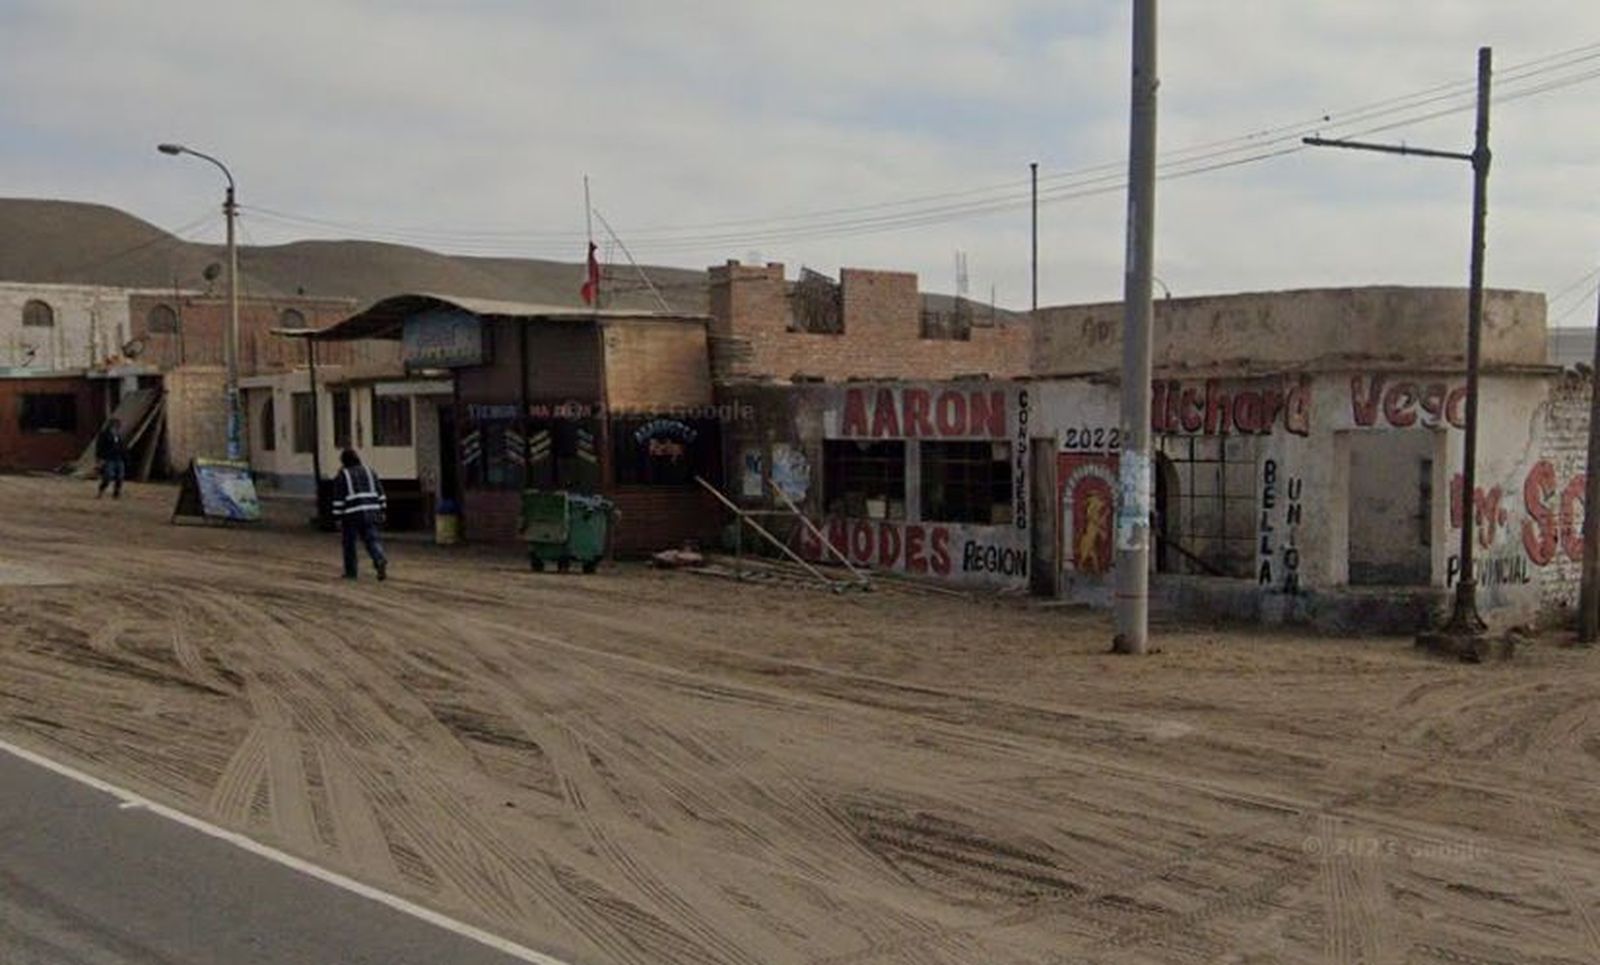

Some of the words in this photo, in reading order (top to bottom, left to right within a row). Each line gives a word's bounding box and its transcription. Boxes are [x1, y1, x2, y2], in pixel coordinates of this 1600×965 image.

[842, 387, 1006, 438] AARON
[1064, 427, 1121, 448] 2022
[1259, 460, 1277, 585] BELLA
[1283, 477, 1302, 595] UNION
[963, 541, 1027, 575] REGION
[1447, 555, 1531, 587] POVINCIAL
